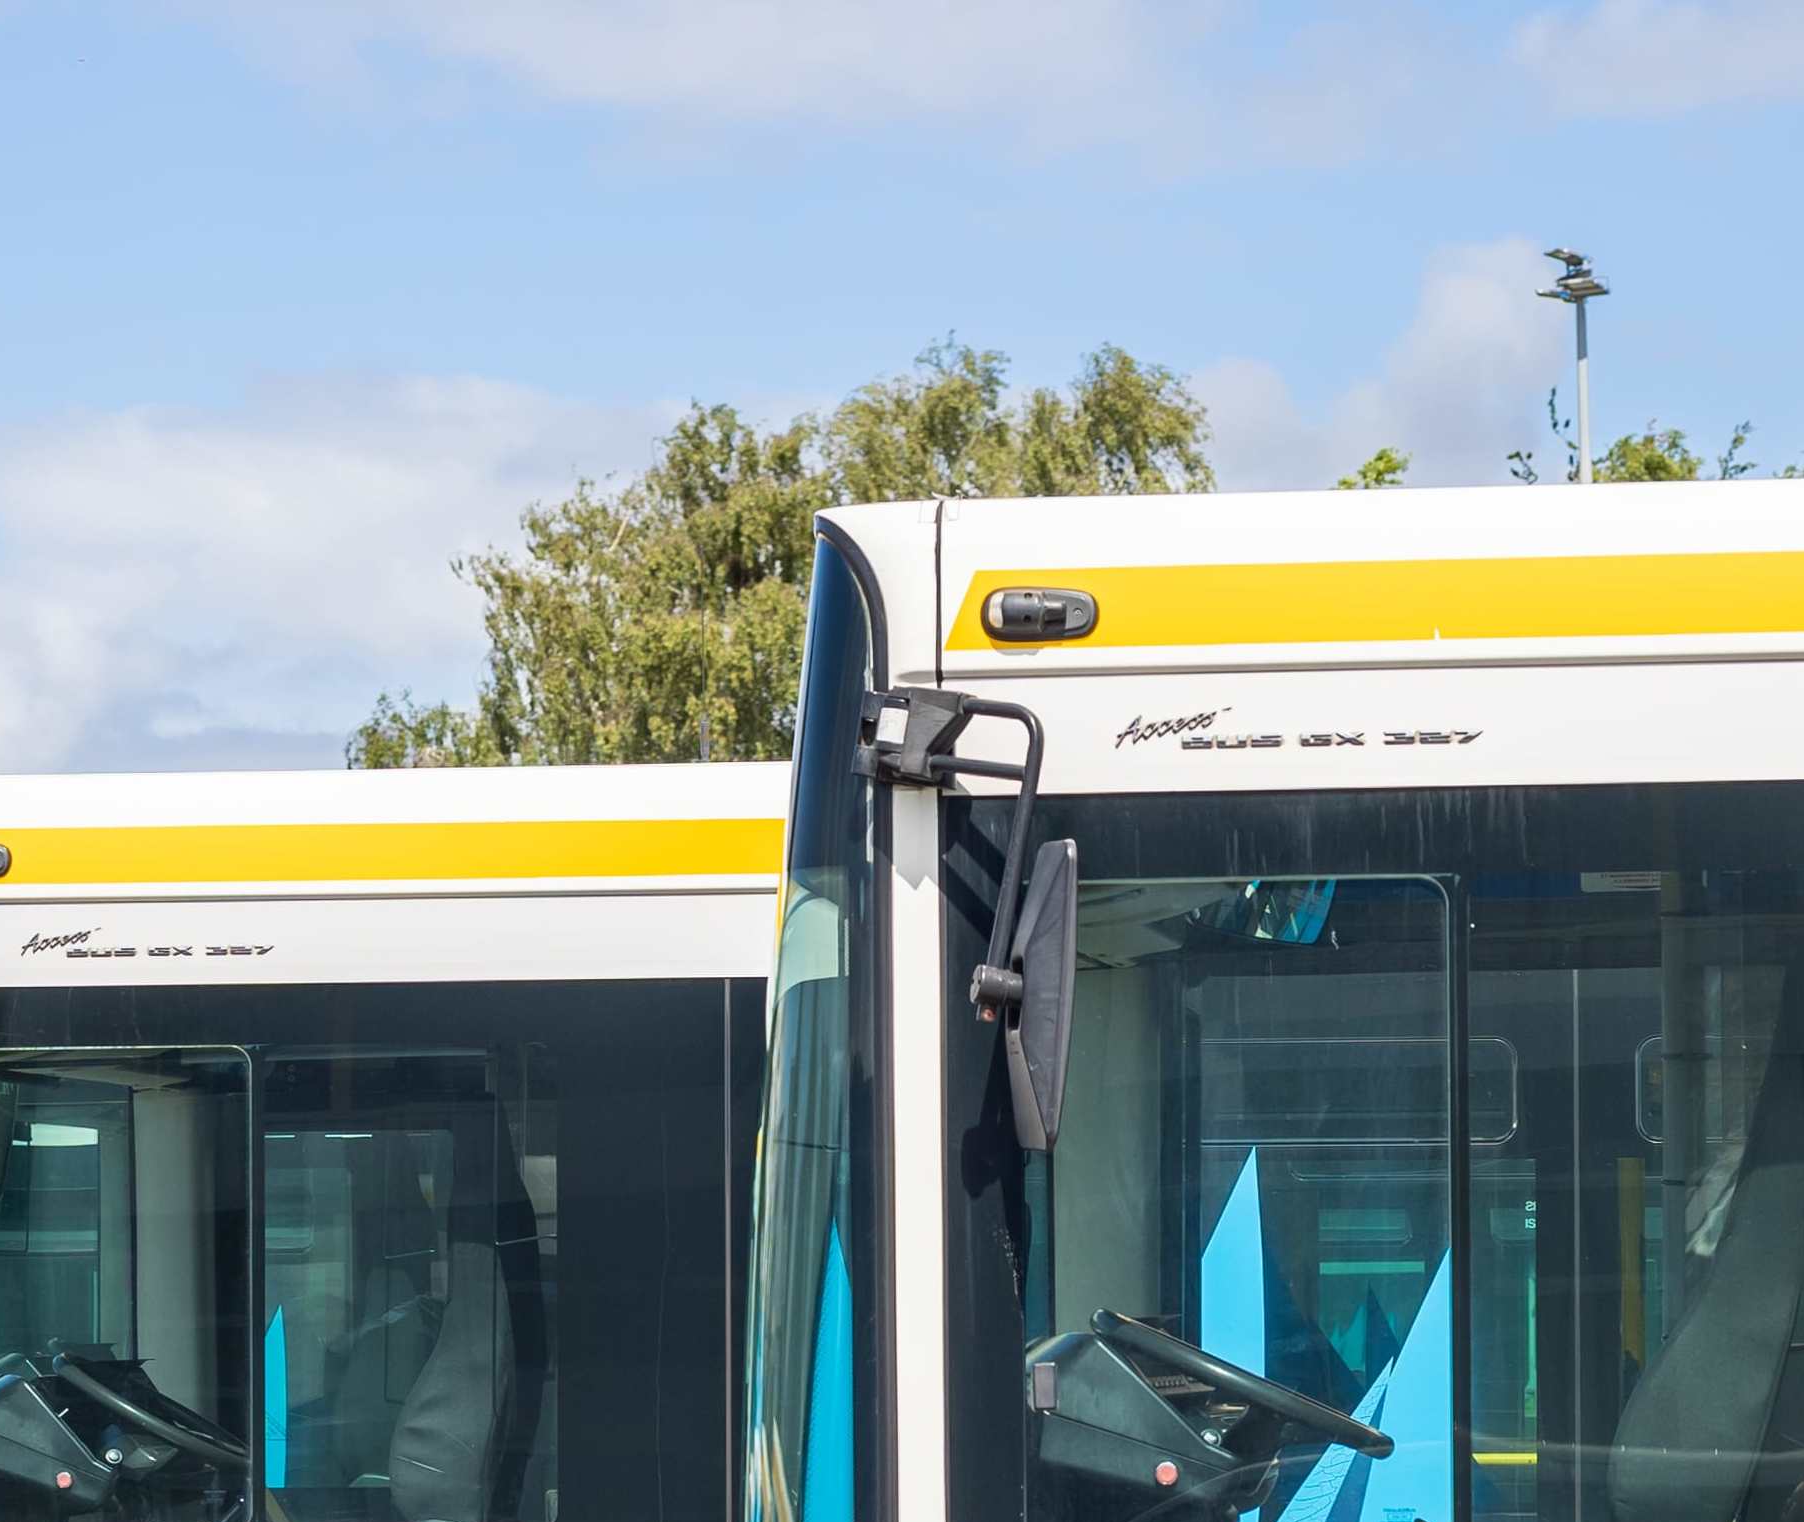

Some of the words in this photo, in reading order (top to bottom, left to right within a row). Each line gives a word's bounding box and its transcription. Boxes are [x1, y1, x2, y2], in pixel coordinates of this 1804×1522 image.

[1181, 733, 1282, 750] BUS
[1299, 732, 1365, 747] GX
[1383, 730, 1482, 745] 327
[66, 947, 136, 958] BUS
[147, 947, 193, 957] GX
